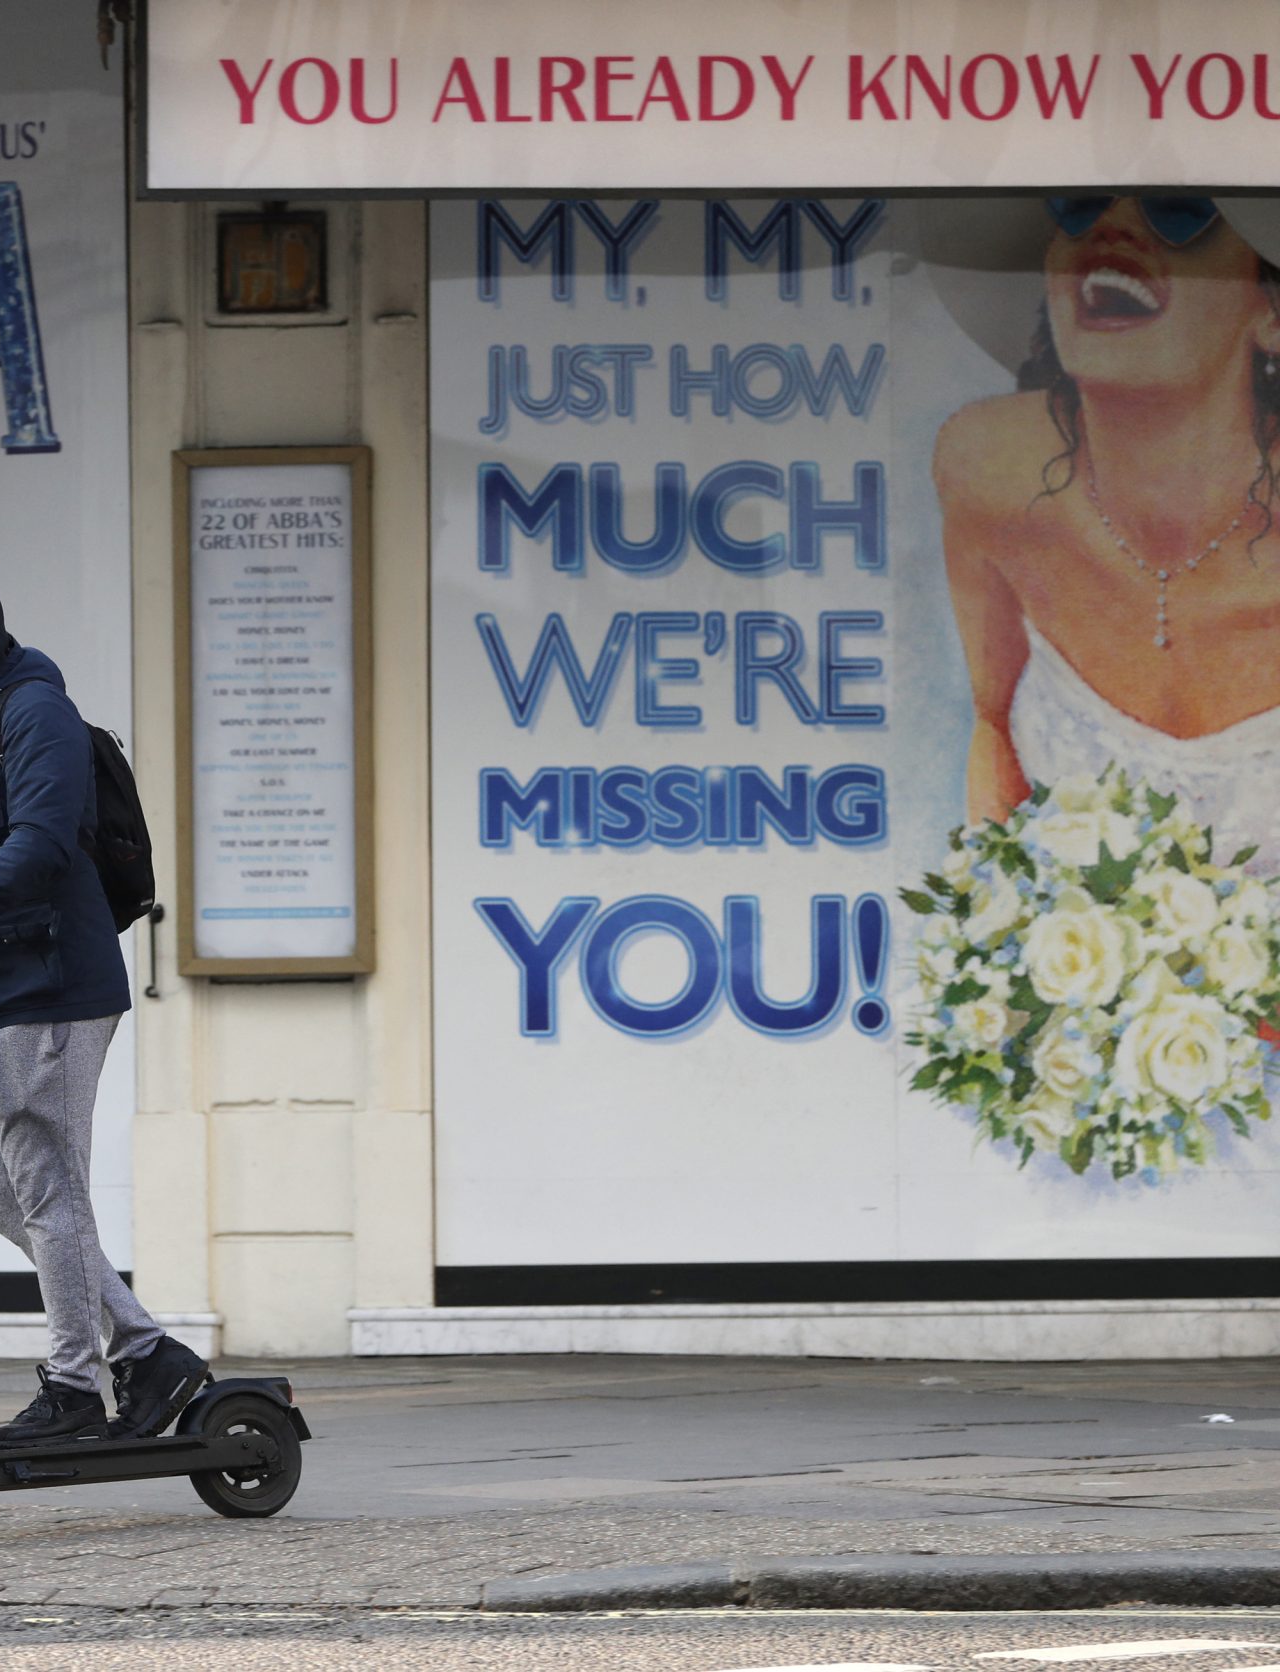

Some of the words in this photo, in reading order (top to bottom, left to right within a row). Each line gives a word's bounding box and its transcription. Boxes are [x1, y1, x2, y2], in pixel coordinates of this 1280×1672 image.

[219, 57, 398, 125] YOU
[432, 55, 814, 122] ALREADY
[848, 53, 1100, 121] KNOW
[1130, 52, 1280, 120] YOU
[478, 199, 659, 307] MY,
[706, 199, 886, 307] MY,
[478, 344, 654, 436] JUST
[670, 343, 888, 418] HOW
[199, 533, 291, 550] GREATEST
[297, 532, 345, 548] HITS:
[201, 514, 226, 531] 22
[232, 512, 259, 530] OF
[266, 510, 343, 529] ABBA'S
[477, 460, 886, 574] MUCH
[475, 610, 886, 728] WE'RE
[479, 764, 887, 850] MISSING
[473, 892, 889, 1039] YOU!
